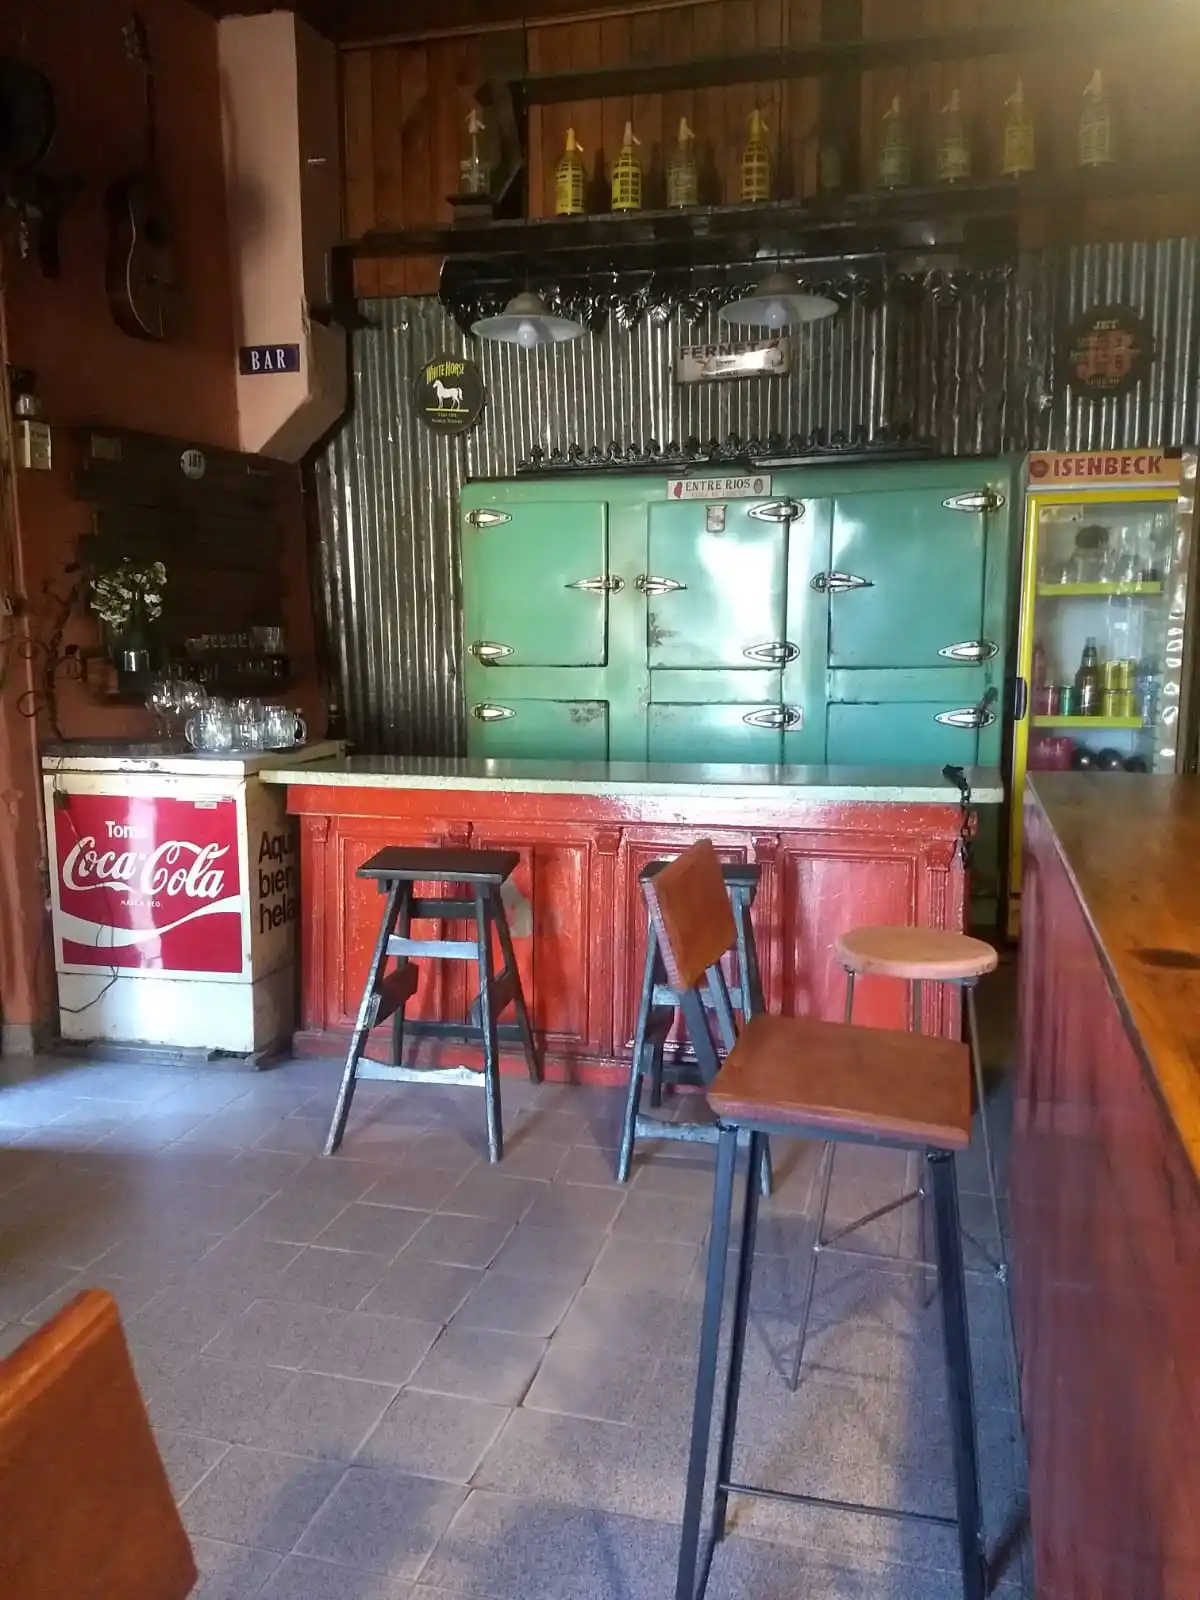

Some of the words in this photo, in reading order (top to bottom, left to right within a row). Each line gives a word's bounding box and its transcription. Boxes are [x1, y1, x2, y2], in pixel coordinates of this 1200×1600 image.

[251, 349, 286, 370] BAR
[680, 341, 760, 360] FERNET
[426, 364, 445, 385] WHITE
[1053, 455, 1162, 477] ISENBECK
[685, 480, 722, 491] ENTRE
[725, 479, 751, 489] RIOS
[105, 820, 149, 838] Tom
